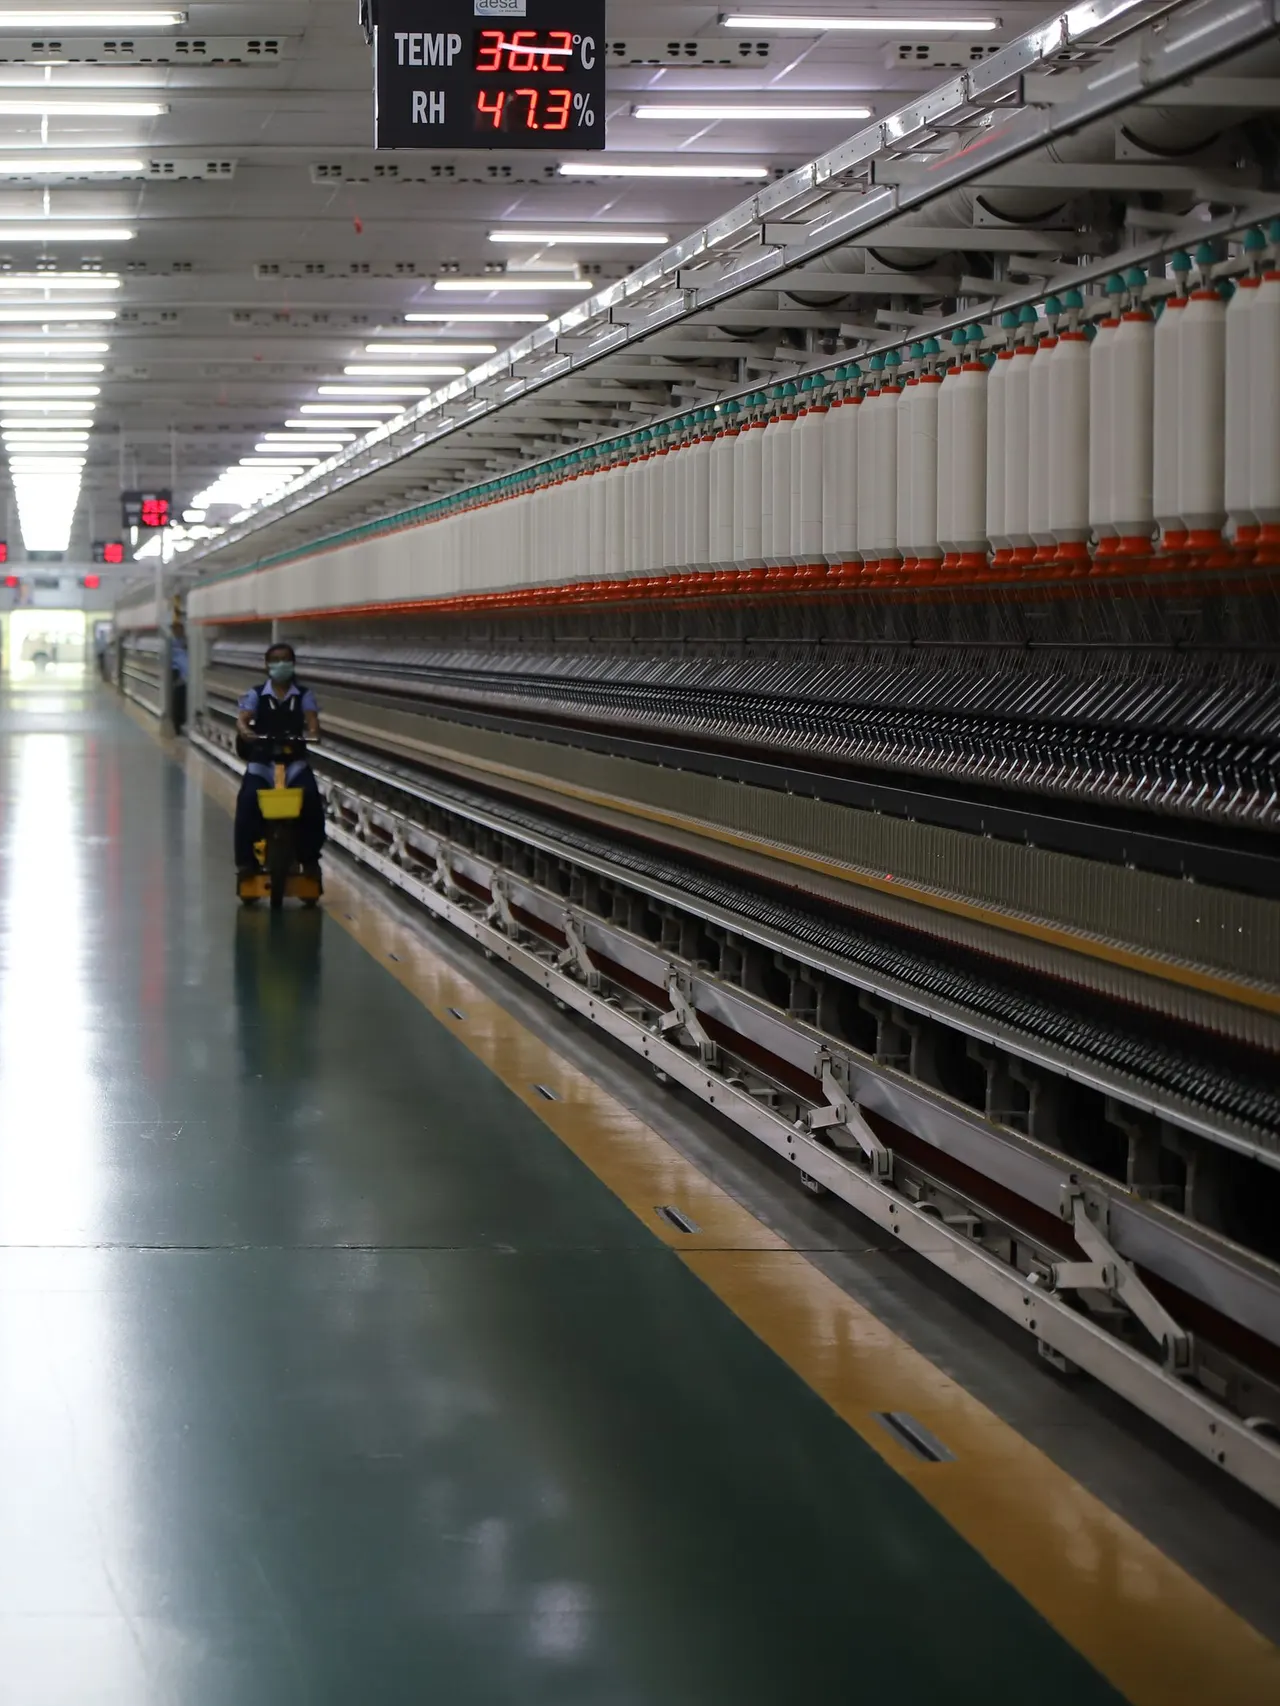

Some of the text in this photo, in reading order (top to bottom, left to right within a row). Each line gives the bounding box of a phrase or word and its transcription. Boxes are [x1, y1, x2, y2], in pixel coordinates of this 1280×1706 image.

[479, 0, 518, 9] aesa
[394, 31, 596, 72] TEMP 36.2 °C
[412, 89, 596, 130] RH 47.3 %
